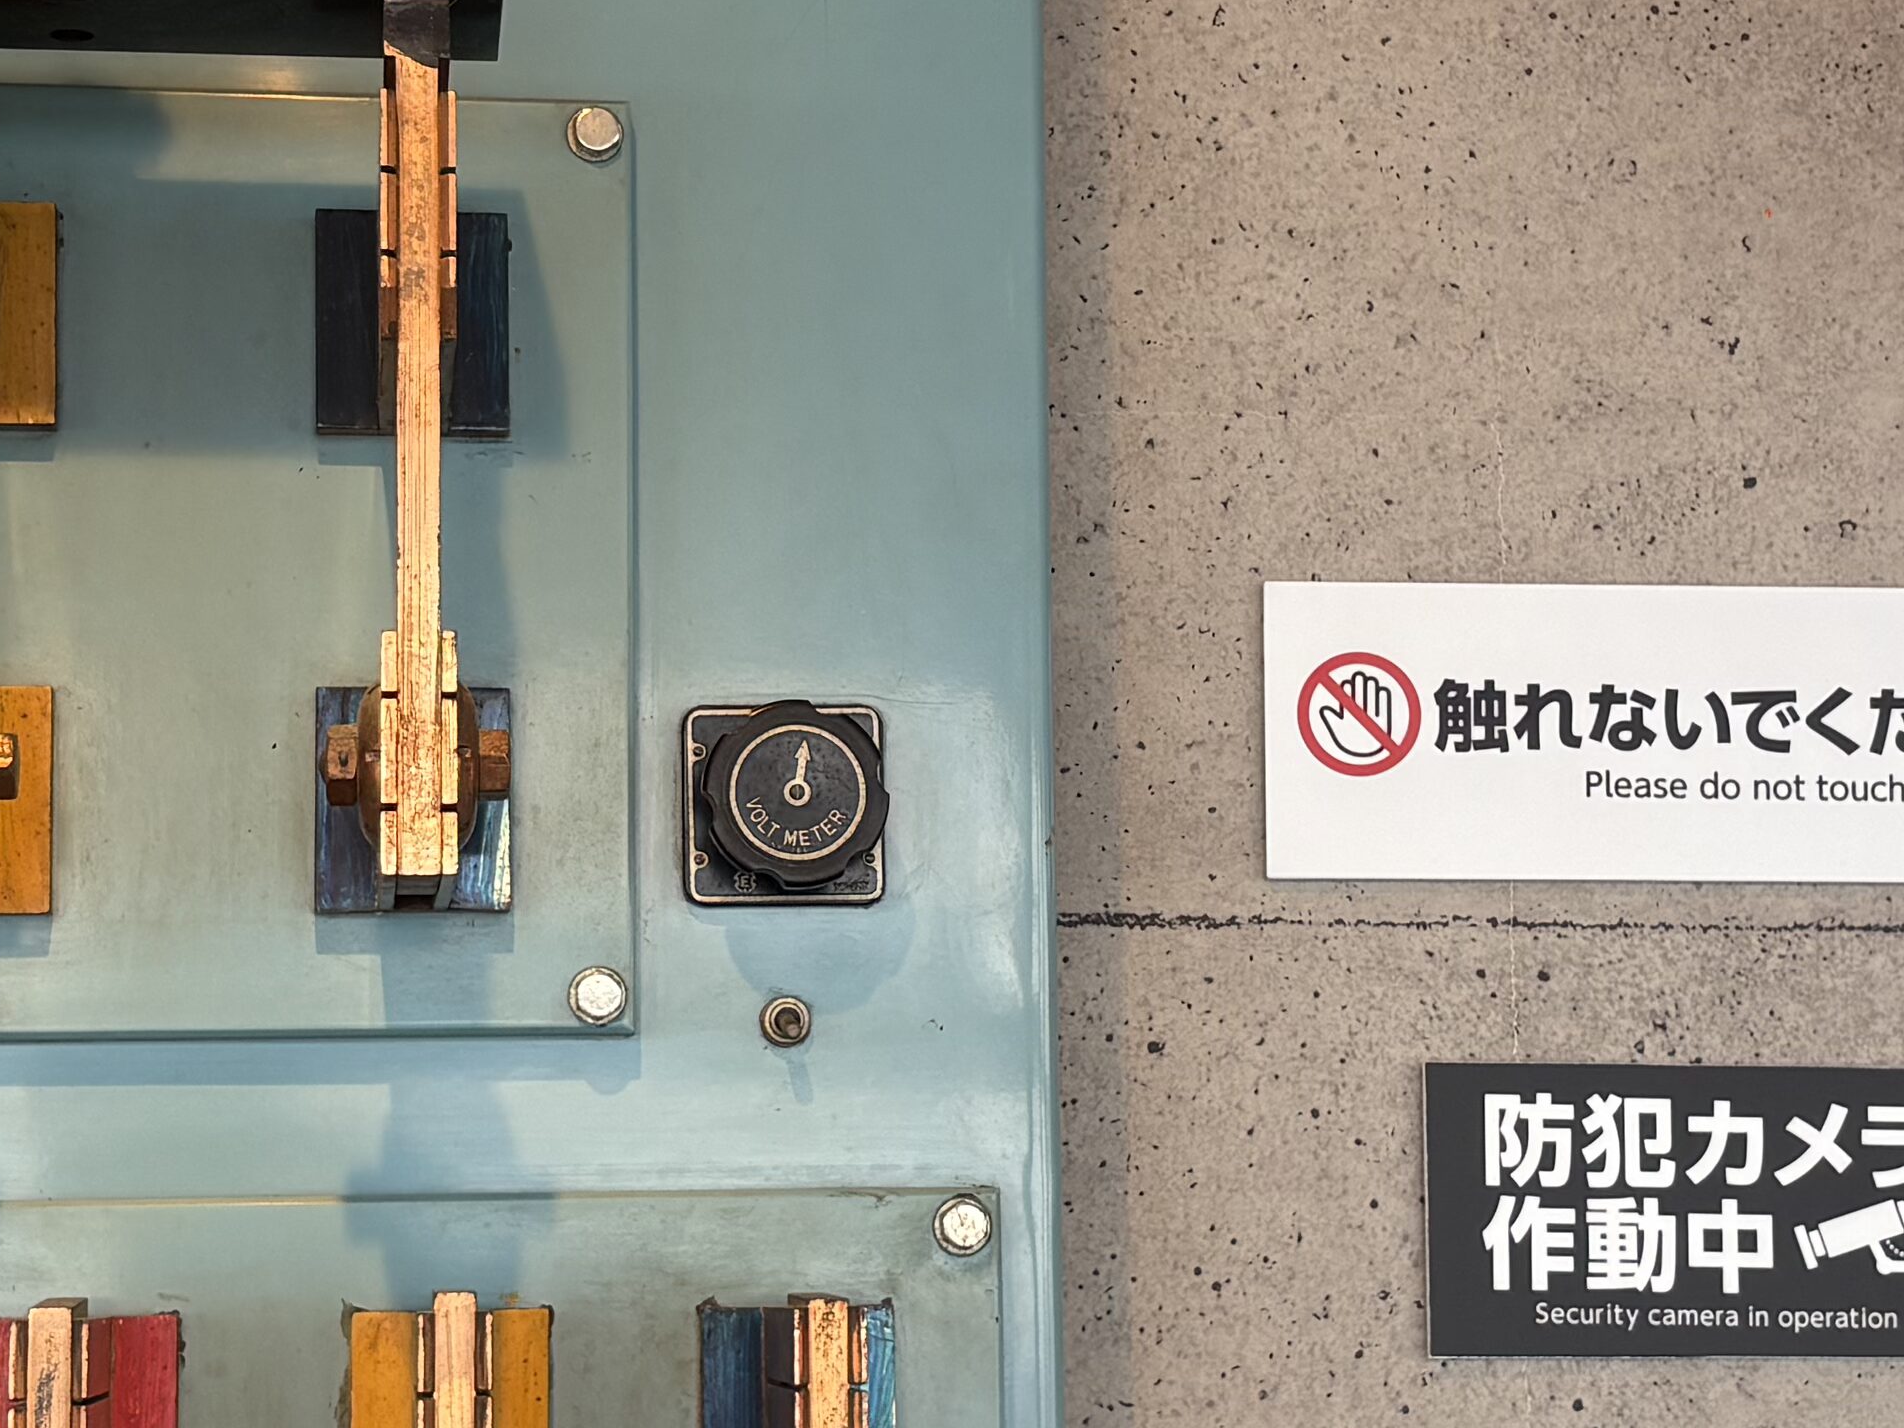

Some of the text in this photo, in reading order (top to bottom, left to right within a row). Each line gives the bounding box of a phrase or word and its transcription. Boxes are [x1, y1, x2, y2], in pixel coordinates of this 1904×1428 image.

[1585, 768, 1688, 800] Please
[1699, 770, 1741, 801] do
[1753, 773, 1806, 802] not
[745, 796, 847, 846] VOLT METER
[1482, 1194, 1774, 1294] 作動中
[1535, 1301, 1899, 1334] Security camera in operation
